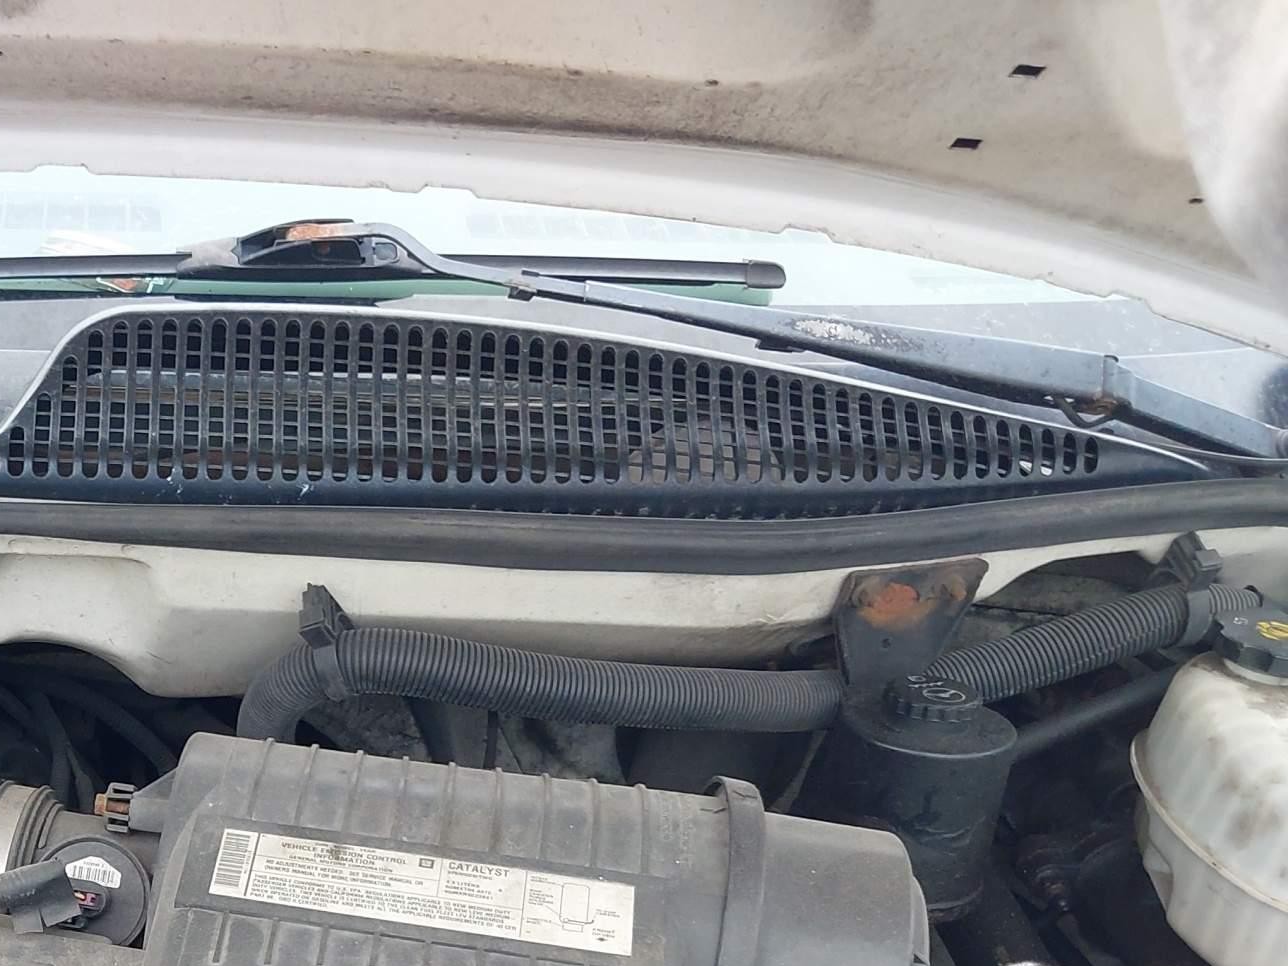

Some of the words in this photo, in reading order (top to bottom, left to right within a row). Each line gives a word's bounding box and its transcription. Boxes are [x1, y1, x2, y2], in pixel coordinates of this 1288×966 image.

[281, 841, 316, 852] VEHICLE
[365, 853, 406, 864] CONTROL
[447, 860, 509, 877] CATALYST
